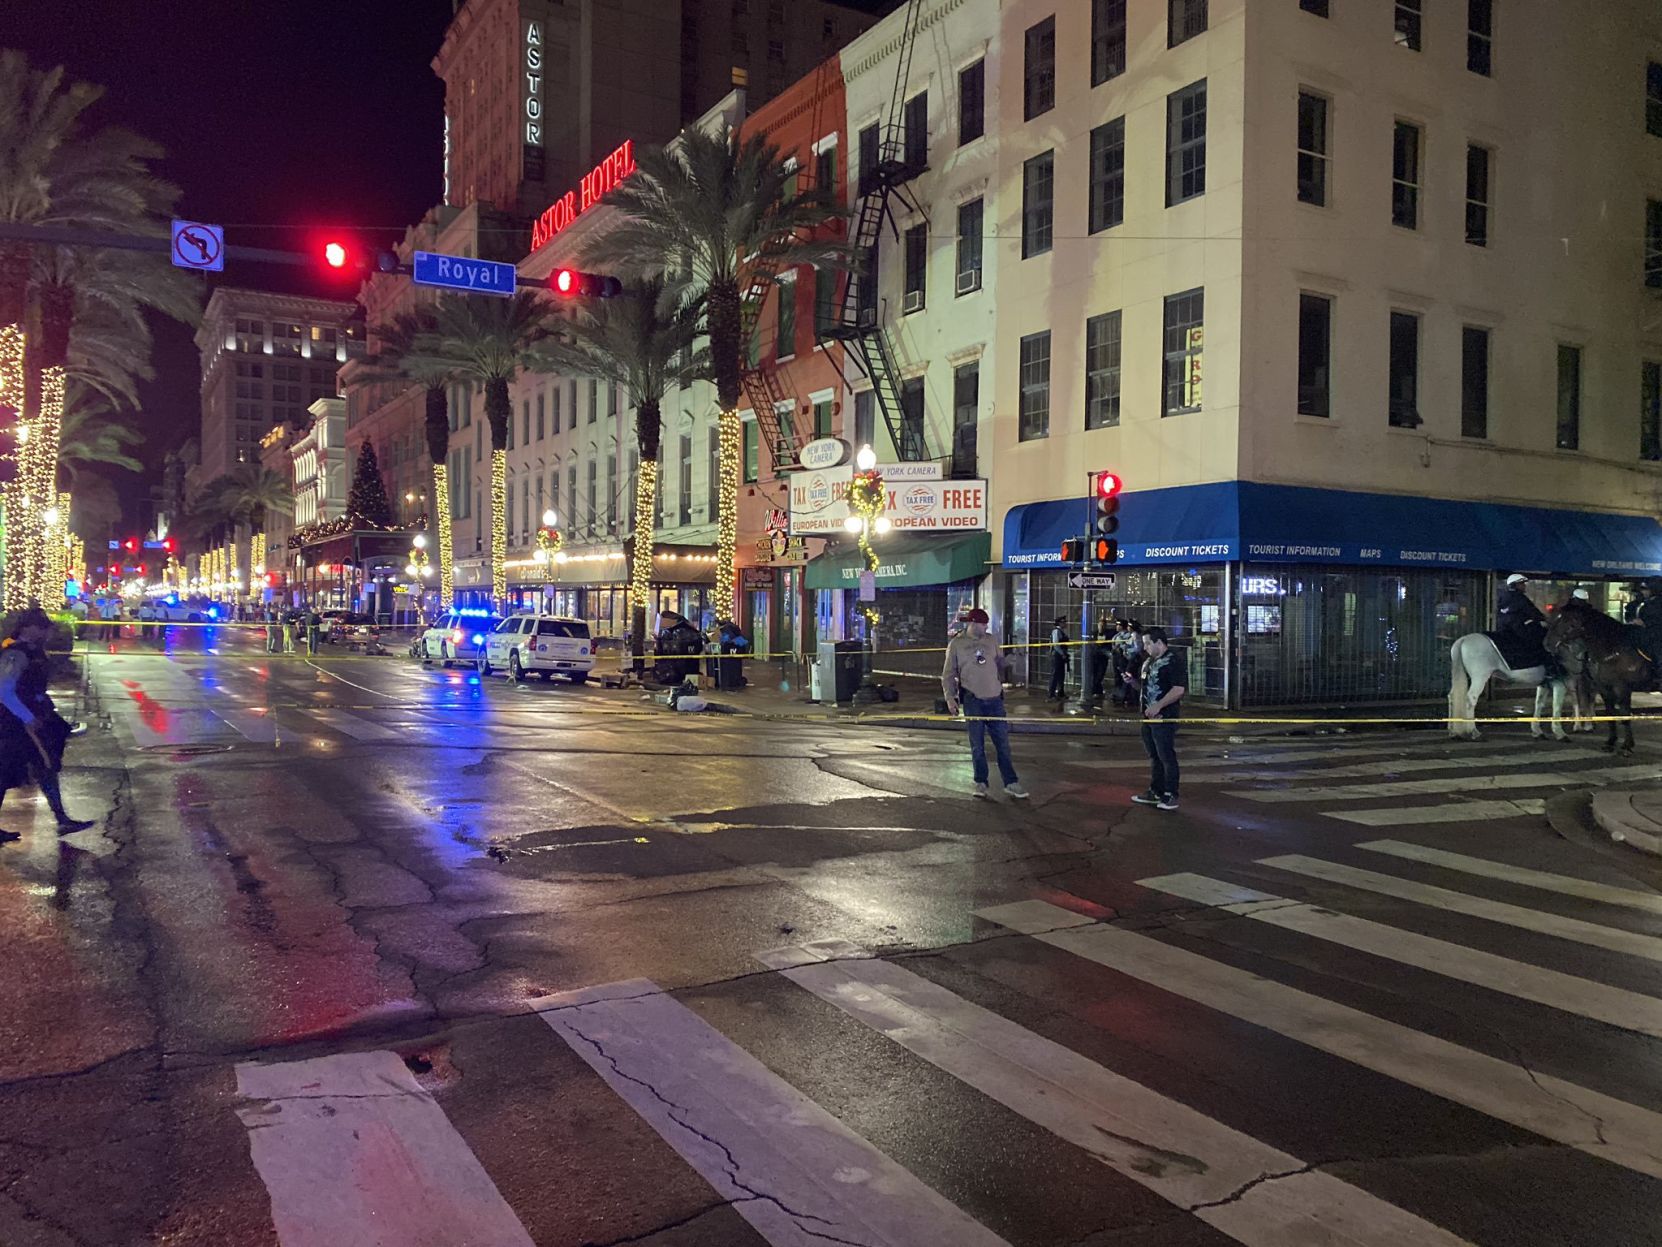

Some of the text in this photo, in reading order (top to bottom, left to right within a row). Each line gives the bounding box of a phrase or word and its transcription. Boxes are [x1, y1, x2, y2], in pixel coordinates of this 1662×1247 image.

[526, 23, 541, 144] ASTOR
[531, 139, 637, 252] ASTOR HOTEL
[438, 257, 498, 287] Royal
[807, 443, 836, 455] NEW YORK
[811, 452, 833, 464] CAMERA
[887, 466, 905, 476] YORK
[907, 466, 937, 475] CAMERA
[793, 486, 807, 506] TAX
[906, 496, 918, 505] TAX
[919, 496, 934, 504] FREE
[943, 489, 982, 509] FREE
[793, 518, 844, 531] EUROPEAN VID
[942, 516, 979, 527] VIDEO
[1008, 554, 1036, 564] TOURIST
[1145, 546, 1190, 557] DISCOUNT
[1191, 545, 1230, 555] TICKETS
[1249, 544, 1467, 562] TOURIST INFORMATION MAPS DISCOUNT TICKETS
[842, 568, 854, 579] NEW
[874, 565, 895, 577] AMERA
[1082, 577, 1110, 585] ONE WAY
